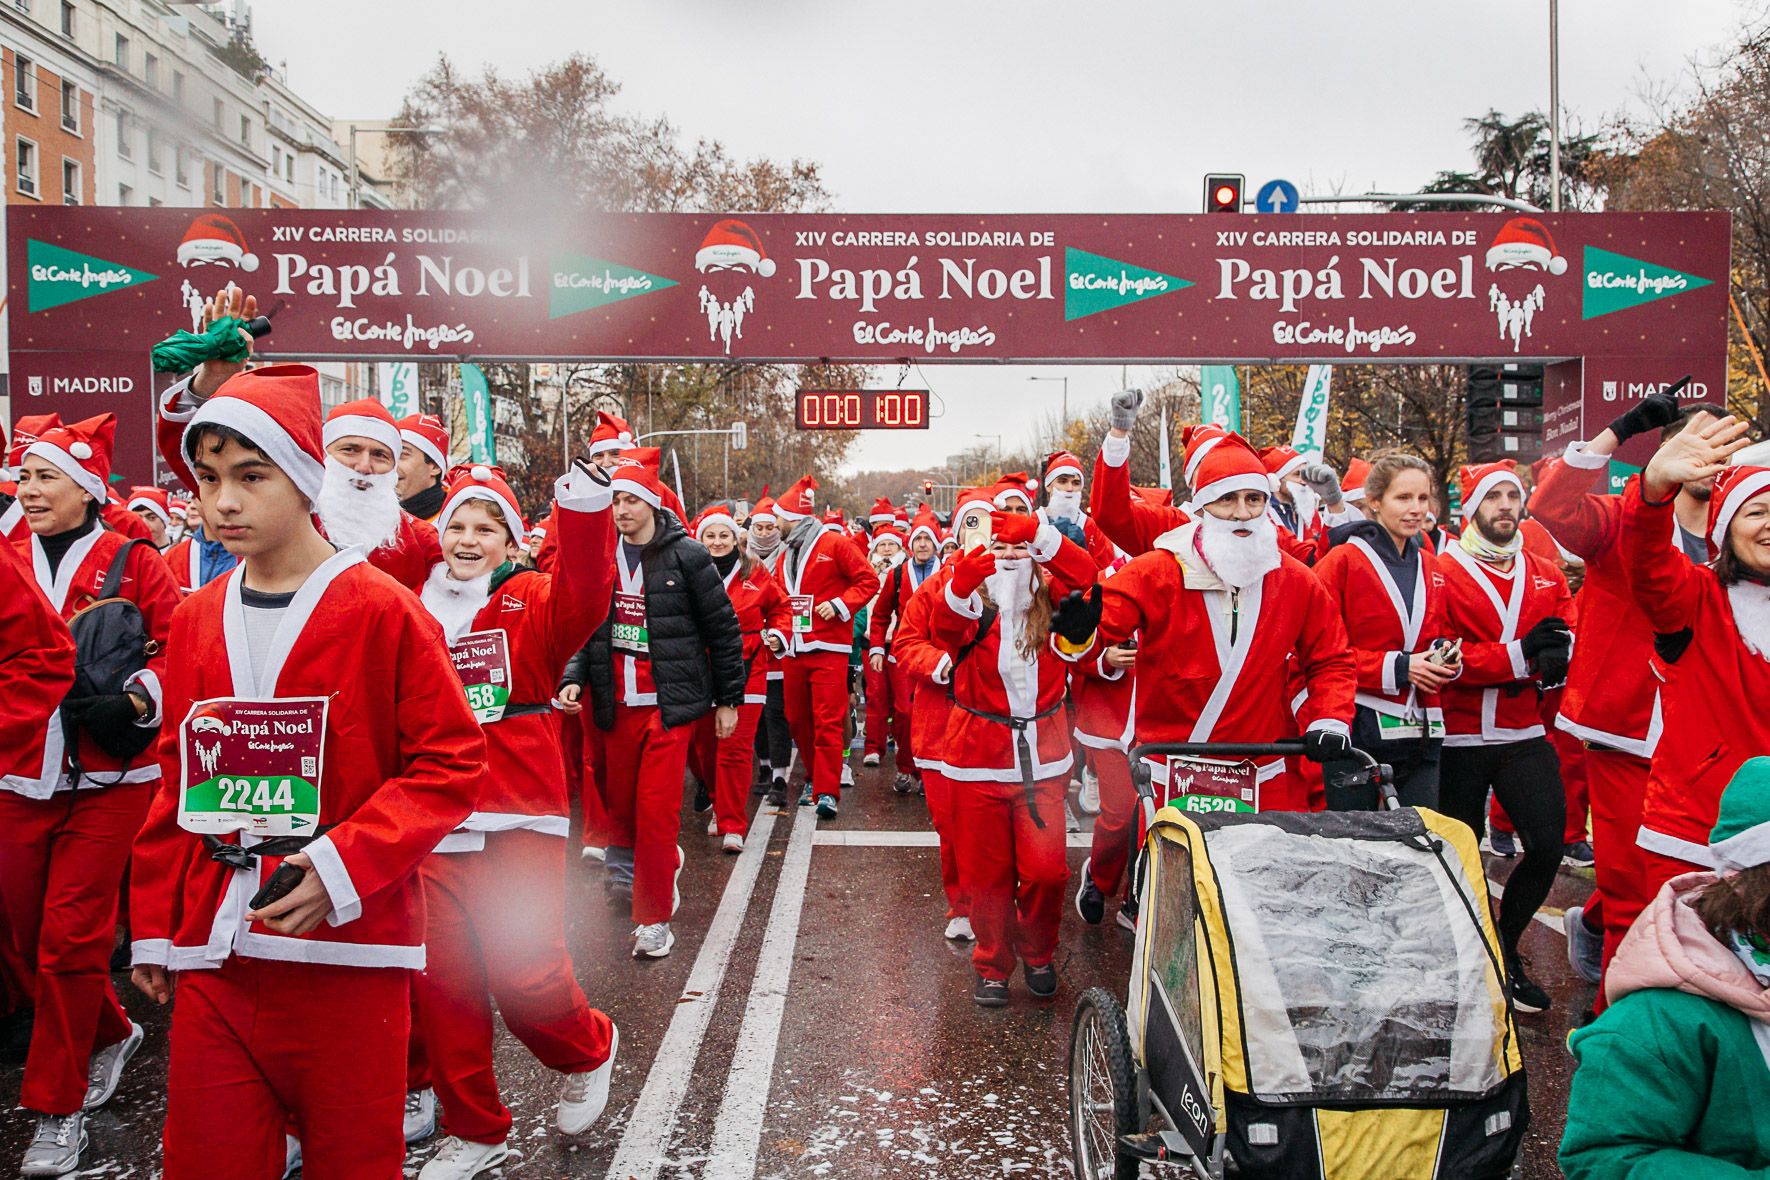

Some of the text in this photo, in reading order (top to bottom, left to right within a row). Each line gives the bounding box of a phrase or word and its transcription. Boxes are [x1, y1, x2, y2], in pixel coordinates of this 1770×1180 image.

[272, 227, 490, 243] XIV CARRERA SOLIDAR
[795, 231, 1055, 247] XIV CARRERA SOLIDARIA DE
[1216, 230, 1477, 247] XIV CARRERA SOLIDARIA DE
[272, 251, 533, 309] Papá Noel
[795, 255, 1056, 313] Papá Noel
[1215, 254, 1477, 313] Papá Noel
[53, 377, 134, 394] MADRID
[450, 643, 497, 662] apá Noel
[464, 684, 495, 709] 58
[232, 718, 313, 739] Papá Noel
[218, 777, 295, 812] 2244
